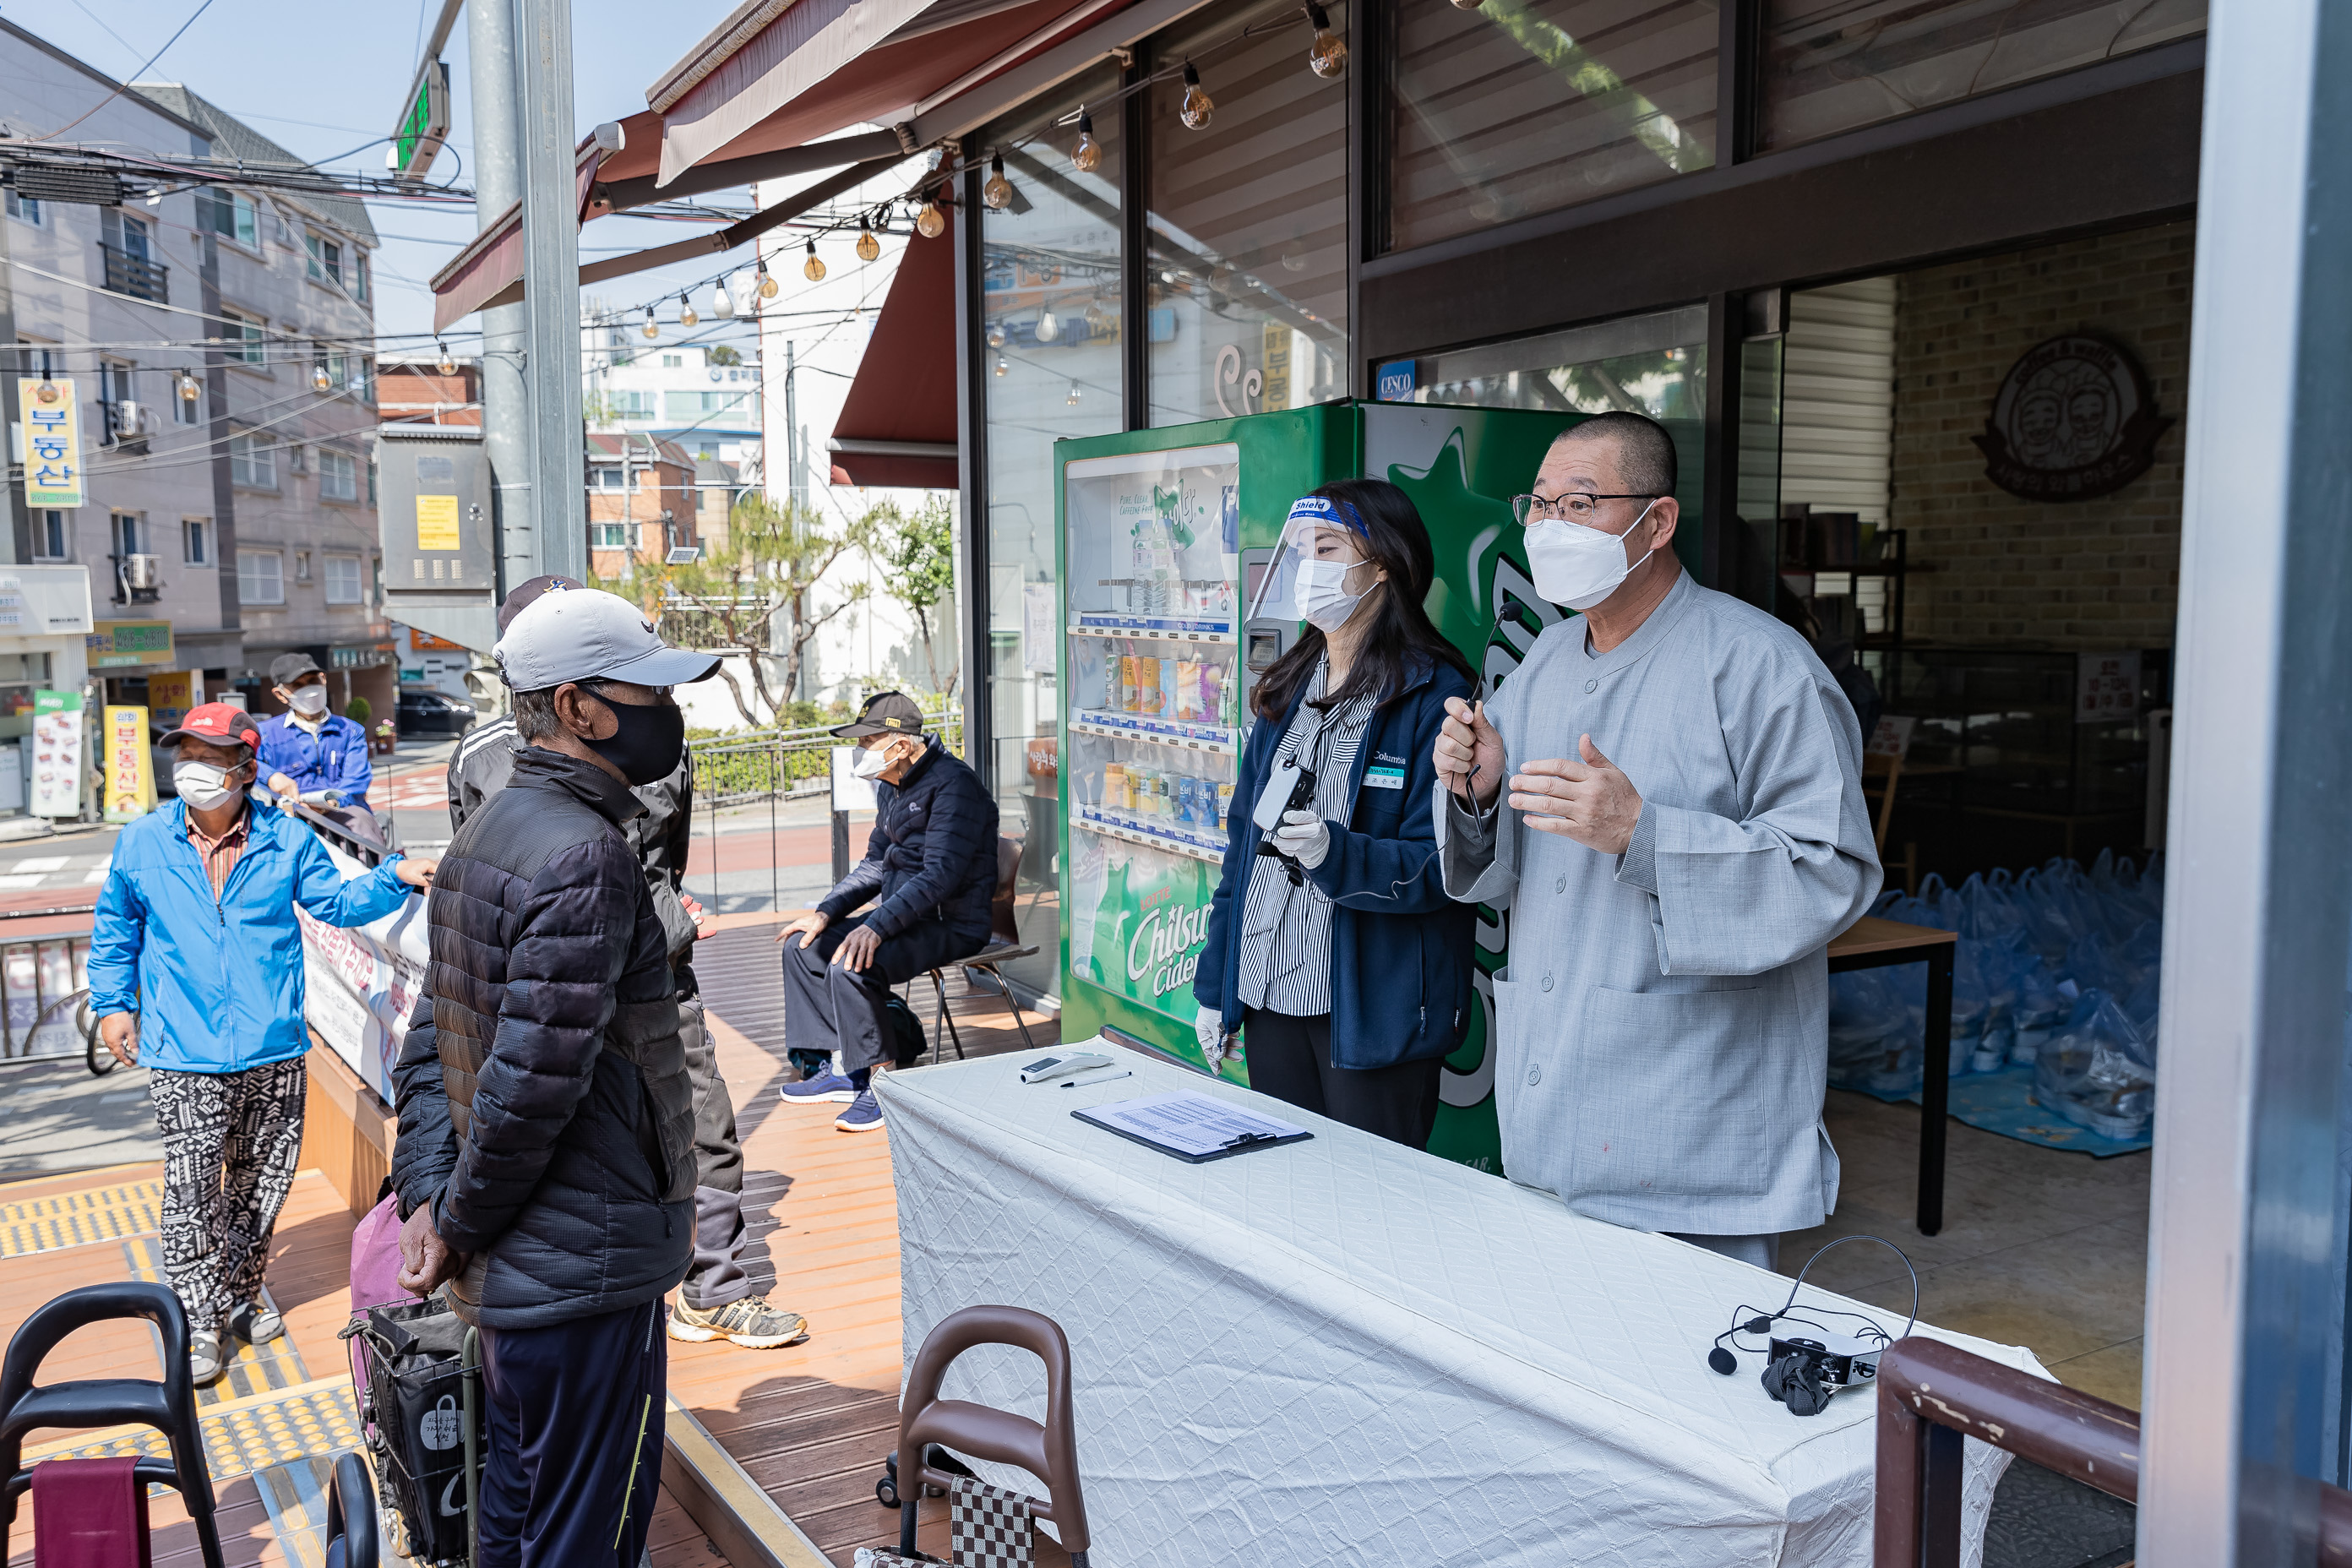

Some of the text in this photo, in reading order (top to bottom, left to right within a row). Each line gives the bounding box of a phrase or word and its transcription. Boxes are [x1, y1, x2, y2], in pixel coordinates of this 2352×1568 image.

[1381, 373, 1411, 395] CESCO
[31, 410, 74, 487] 부동산
[1195, 623, 1214, 631] DRINKS
[117, 727, 138, 792] 부동산
[1374, 750, 1406, 765] Columbia
[1141, 885, 1172, 912] LOTTE
